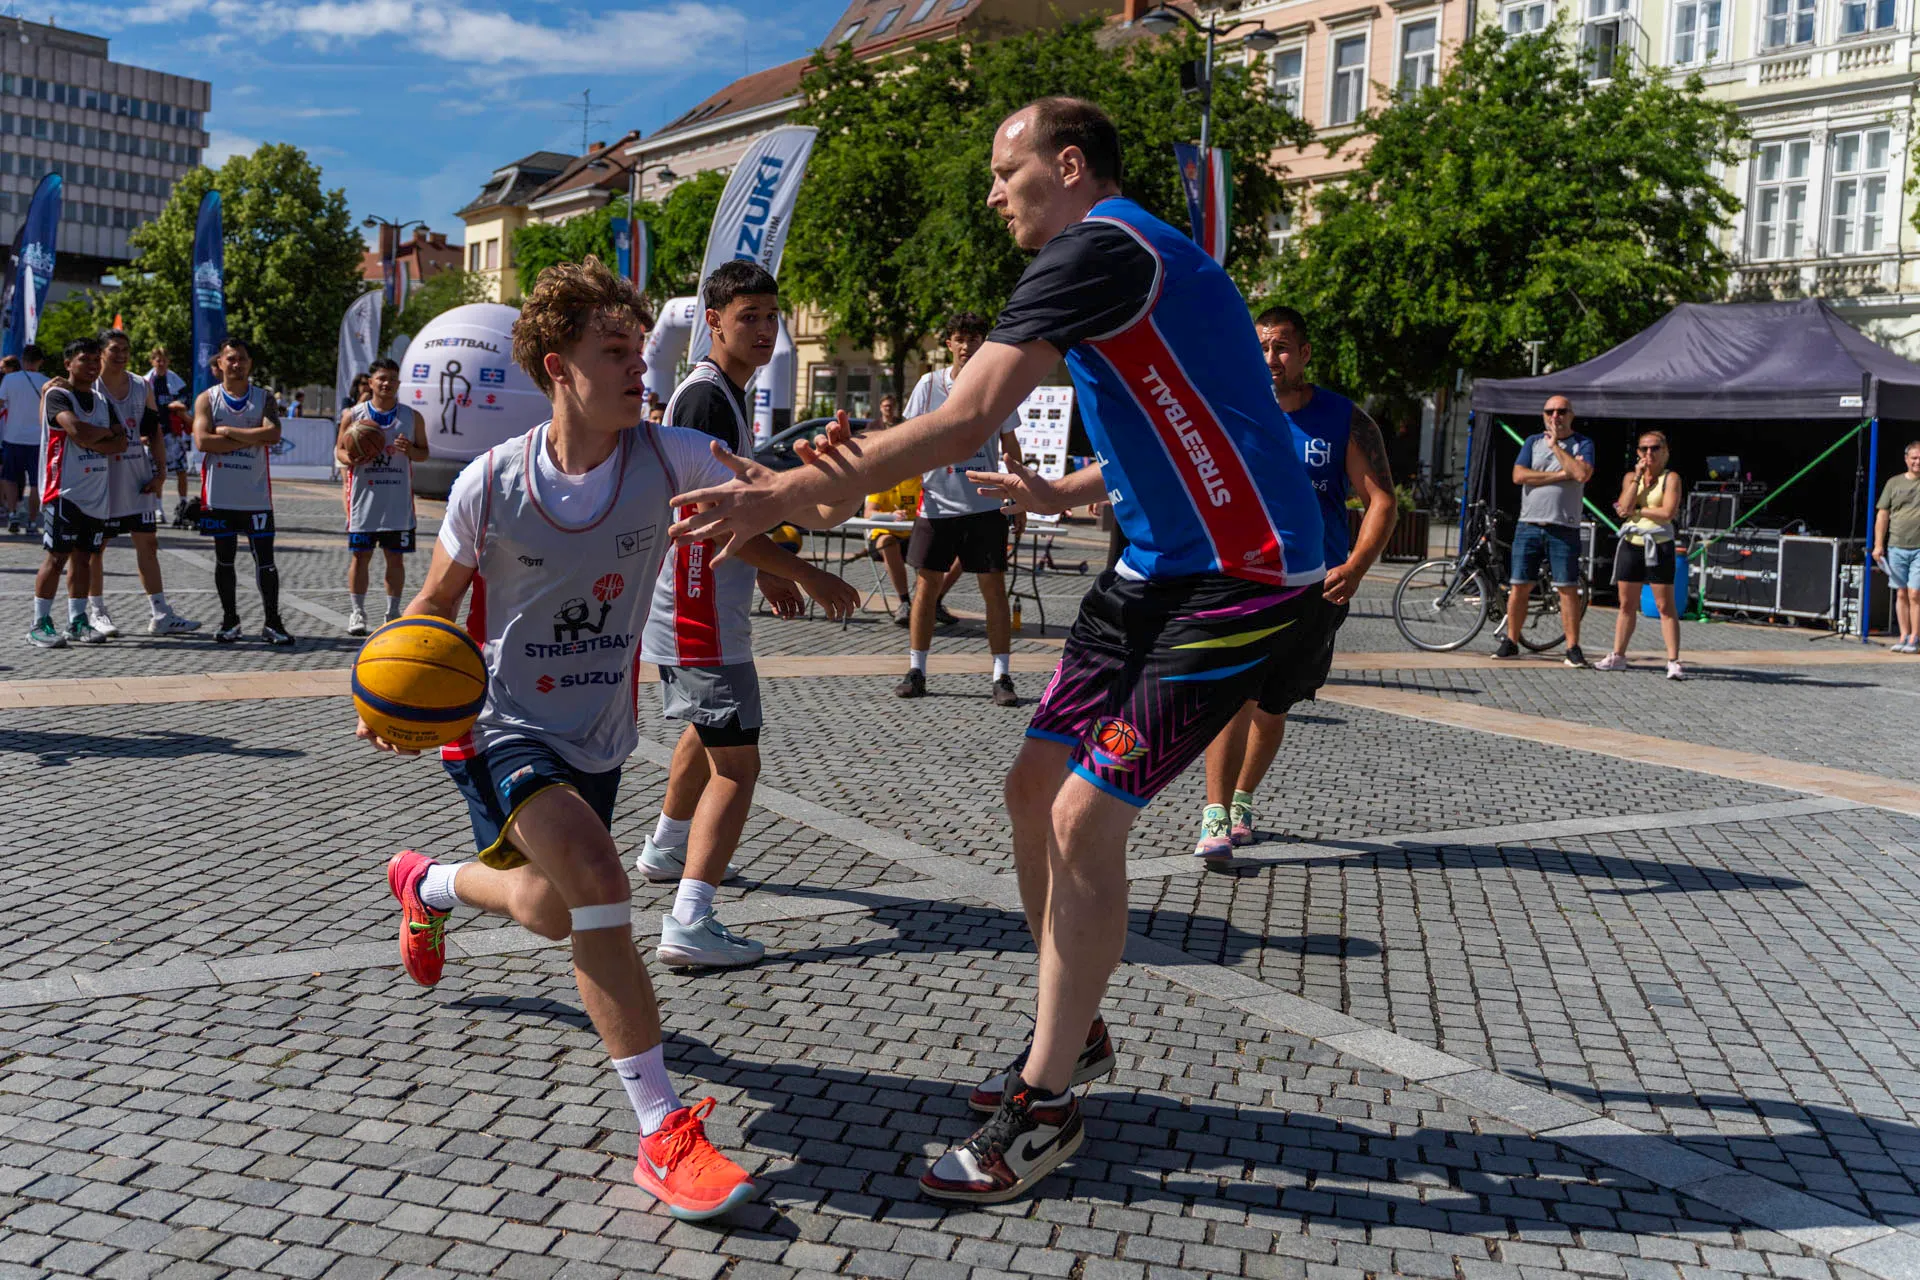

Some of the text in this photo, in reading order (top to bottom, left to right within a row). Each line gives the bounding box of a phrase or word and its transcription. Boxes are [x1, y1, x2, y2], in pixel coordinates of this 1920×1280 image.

[734, 156, 783, 263] ZUKI
[424, 338, 501, 354] STREETBALL
[1142, 364, 1231, 508] STREETBALL
[251, 513, 268, 531] 17
[400, 532, 410, 547] 5
[525, 634, 634, 658] STREETBA
